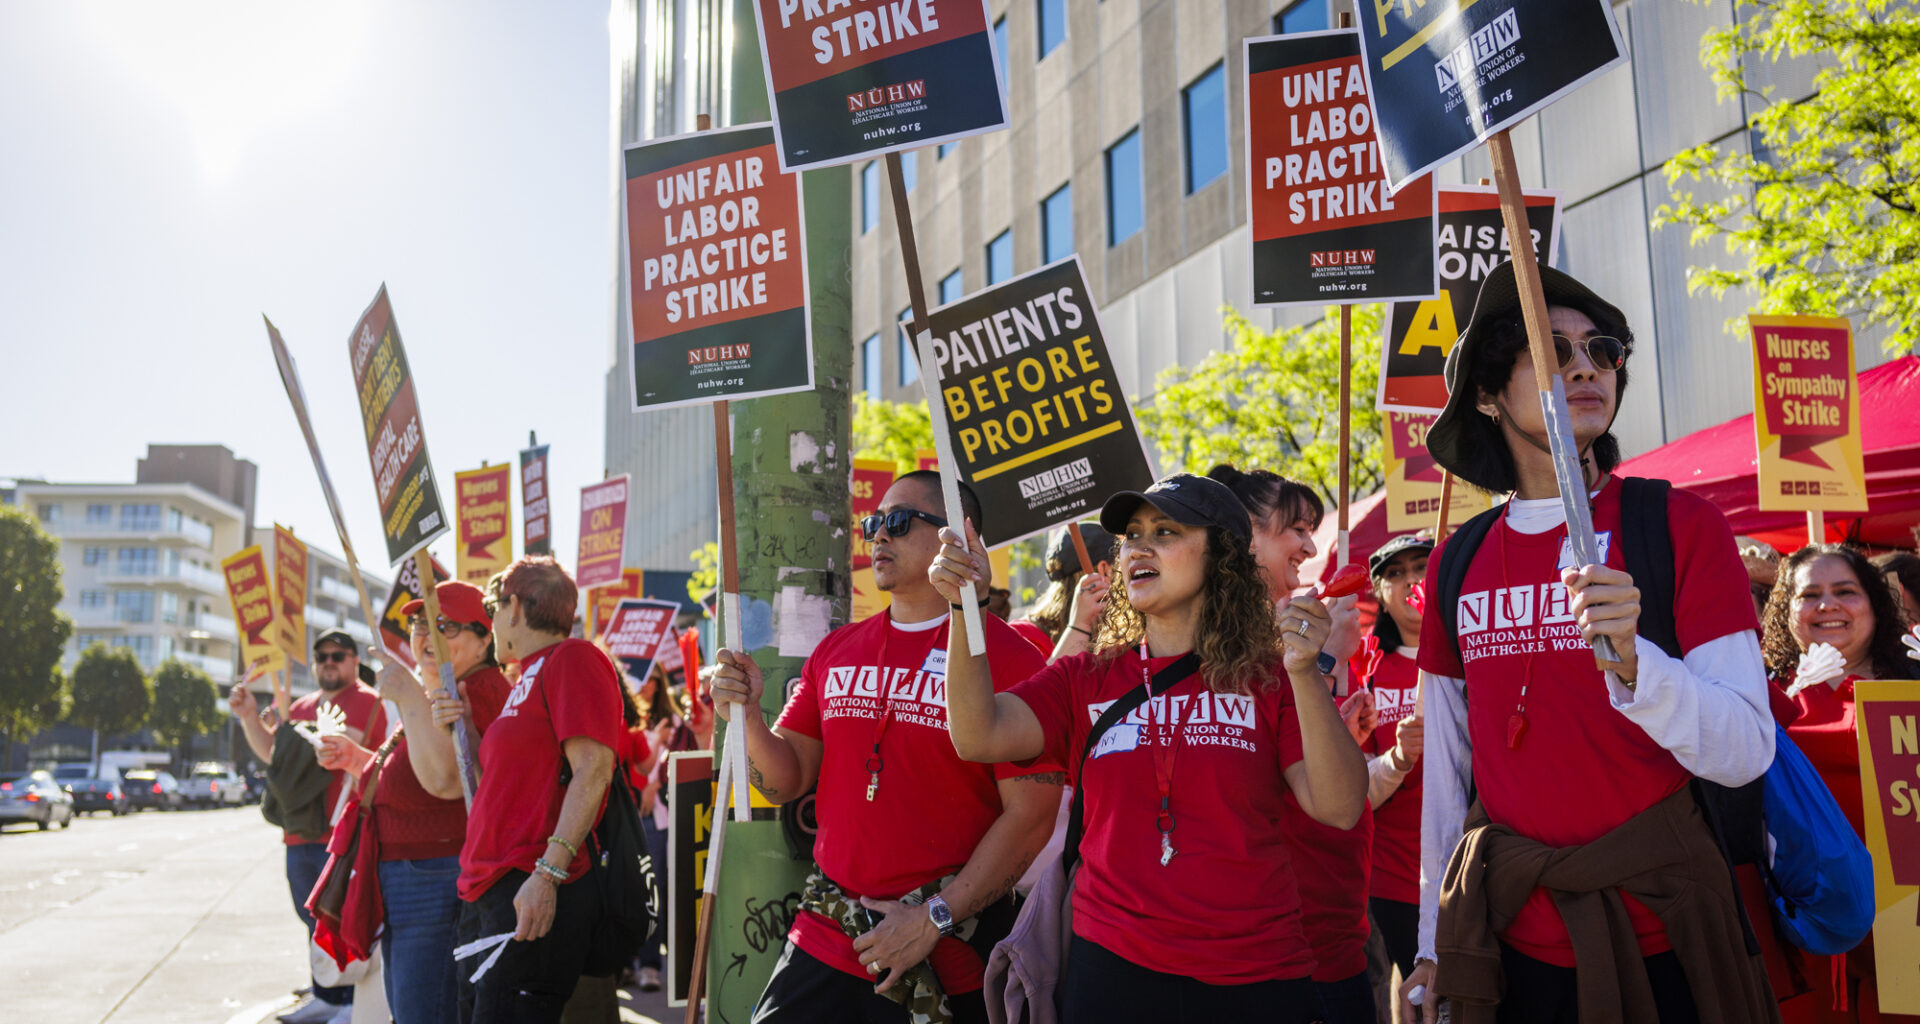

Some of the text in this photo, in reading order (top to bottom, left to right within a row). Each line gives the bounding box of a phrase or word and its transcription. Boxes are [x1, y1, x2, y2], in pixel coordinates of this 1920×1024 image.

[811, 0, 939, 64] STRIKE
[1436, 10, 1517, 90] NUHW
[1479, 53, 1505, 75] UNION
[1506, 46, 1516, 57] OF
[1487, 53, 1525, 82] WORKERS
[848, 81, 924, 110] NUHW
[1282, 64, 1366, 108] UNFA
[852, 104, 928, 125] HEALTHCARE WORKERS
[856, 106, 889, 118] NATIONAL
[890, 101, 912, 110] UNION
[864, 122, 922, 140] nuhw.org
[1290, 103, 1376, 147] LABO
[1265, 140, 1378, 190] PRACTI
[657, 156, 764, 209] UNFAIR
[1288, 179, 1395, 225] STRIKE
[664, 196, 760, 247] LABOR
[644, 228, 787, 291] PRACTICE
[1311, 250, 1375, 266] NUHW
[666, 271, 768, 324] STRIKE
[1319, 283, 1367, 292] nuhw.org
[932, 287, 1083, 380] PATIENTS
[1766, 333, 1830, 361] Nurses
[689, 344, 750, 364] NUHW
[1778, 362, 1792, 374] on
[697, 377, 744, 389] nuhw.org
[943, 335, 1100, 422] BEFORE
[1766, 372, 1846, 400] Sympathy
[958, 379, 1113, 464] PROFITS
[1782, 399, 1840, 426] Strike
[398, 415, 420, 464] CARE
[1021, 459, 1090, 496] NUHW
[591, 506, 613, 531] ON
[1046, 498, 1086, 517] nuhw.org
[580, 527, 622, 557] STRIKE
[1459, 585, 1574, 631] NUH
[1466, 625, 1582, 649] NATIONAL UNION
[1462, 641, 1545, 664] HEALTHCARE
[828, 697, 940, 718] NATIONAL UNION OF
[895, 711, 949, 731] WORKERS
[1184, 735, 1257, 752] WORKERS
[1225, 726, 1243, 737] OF
